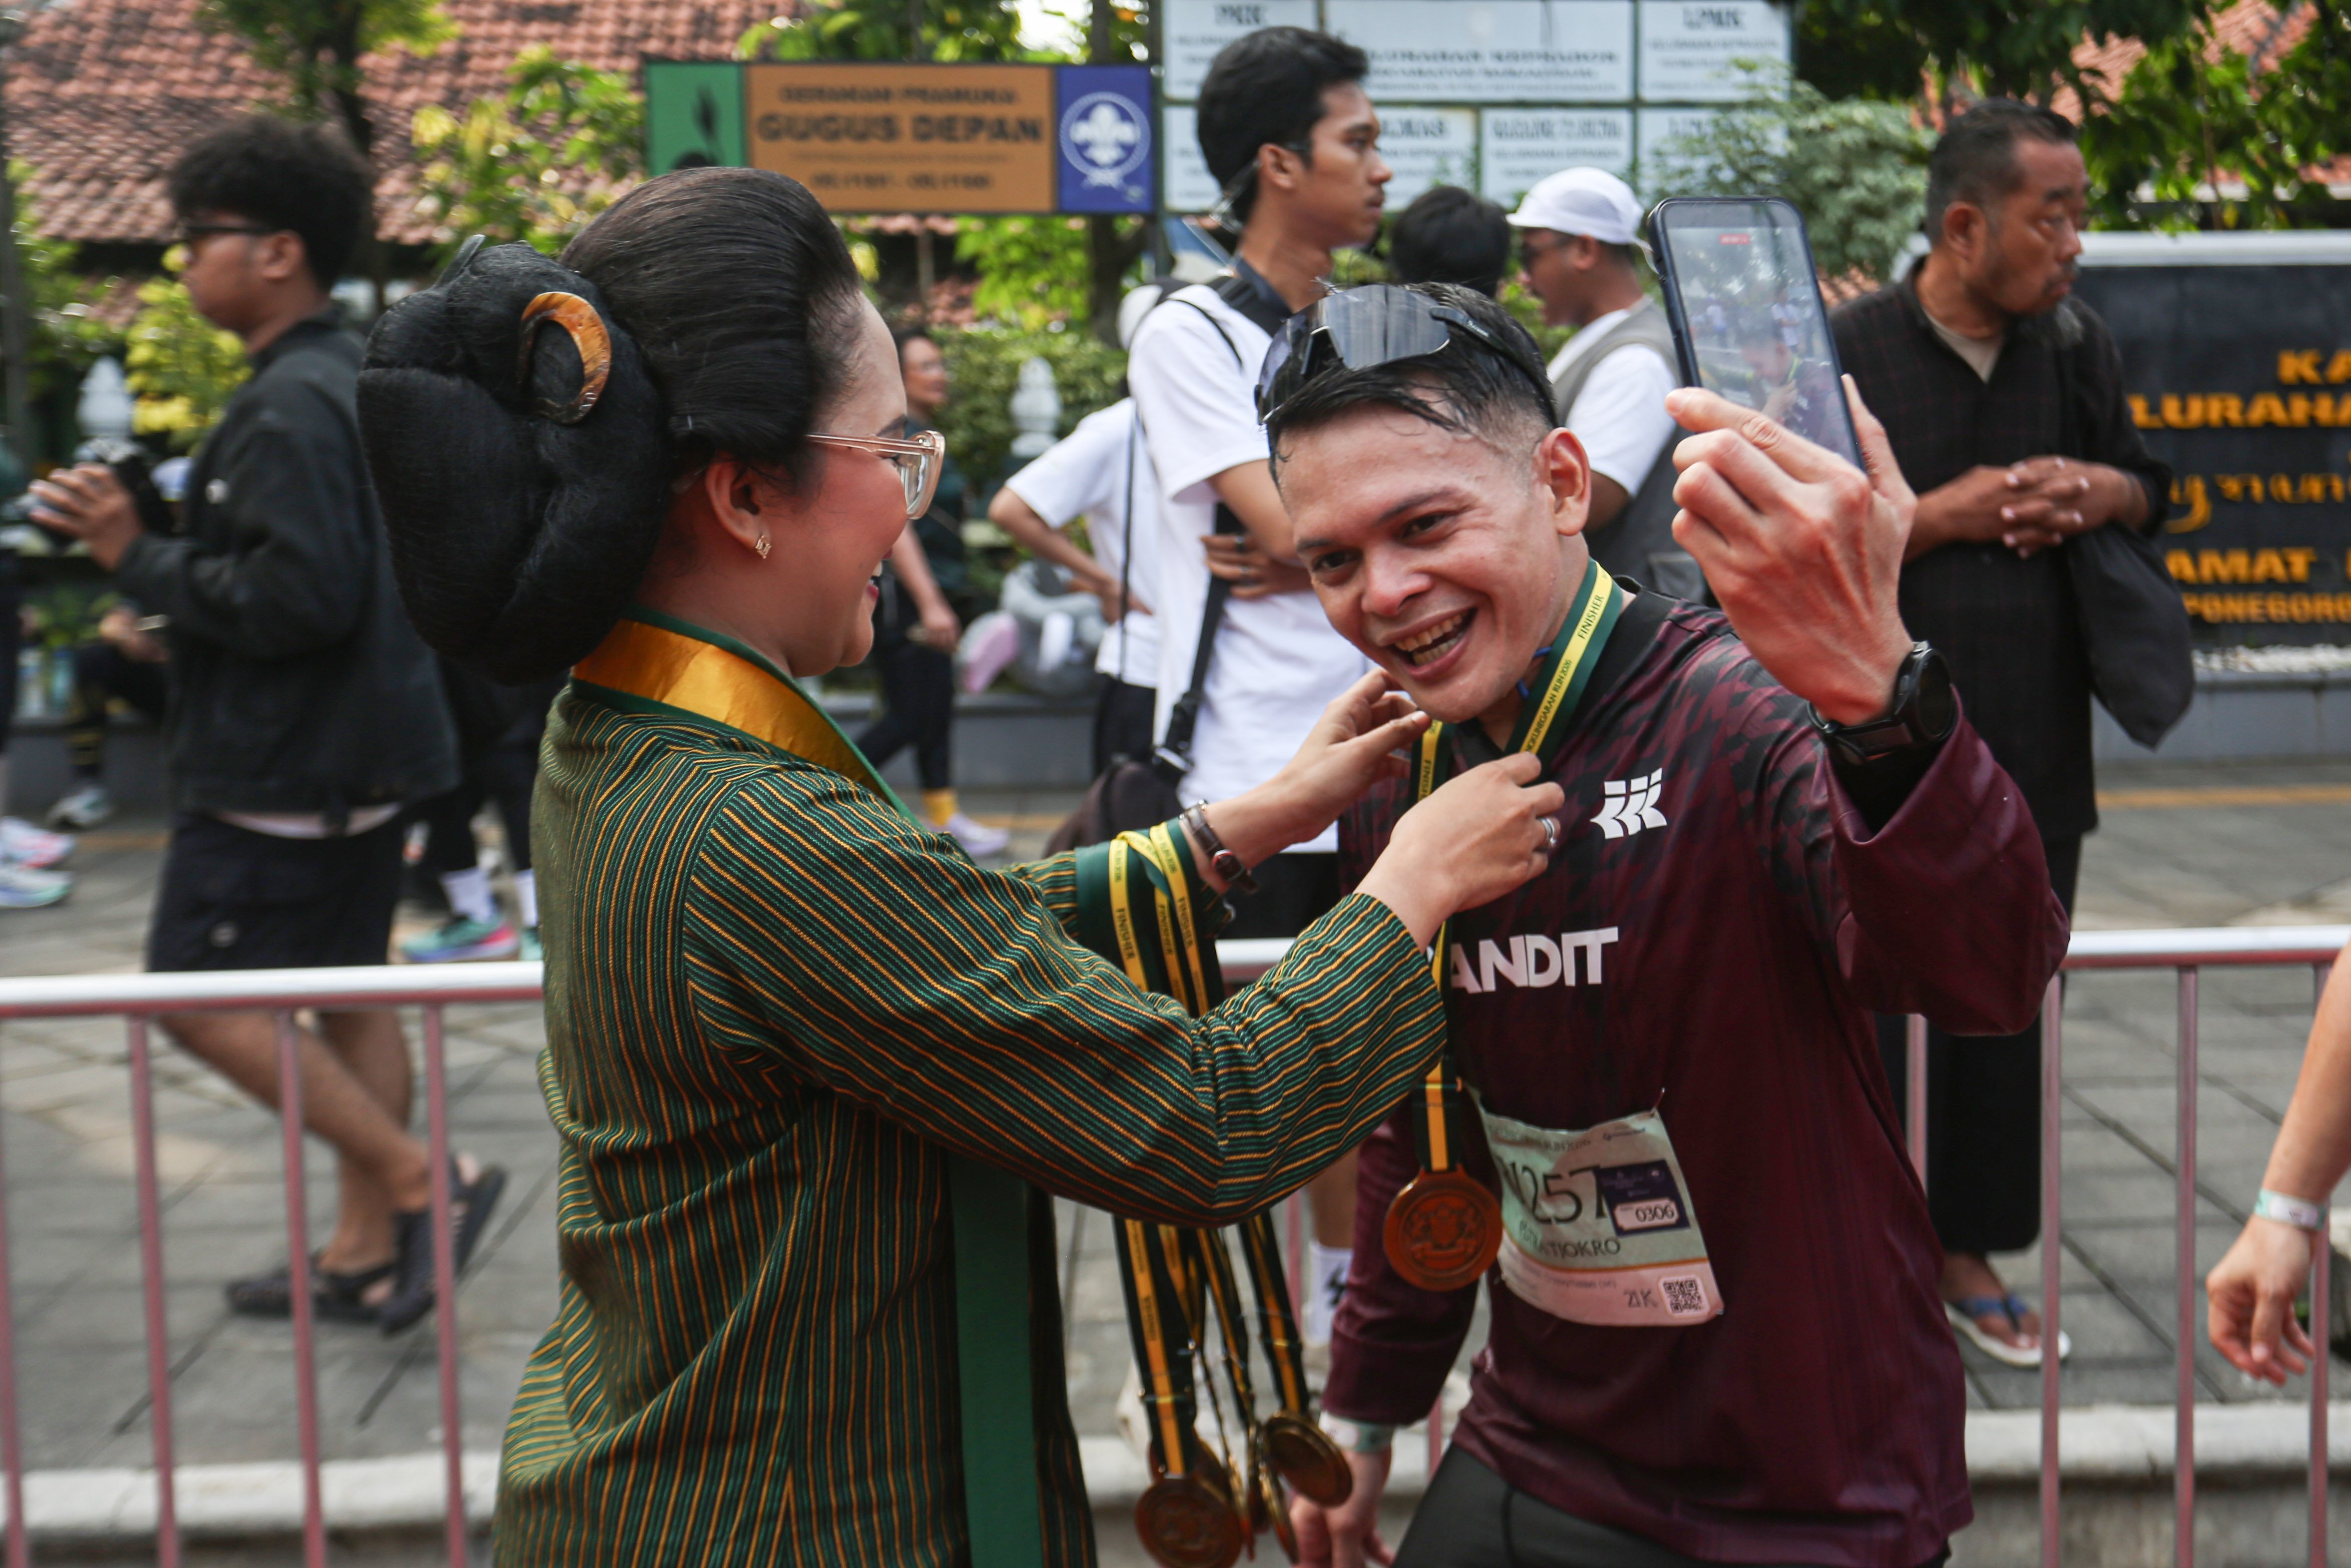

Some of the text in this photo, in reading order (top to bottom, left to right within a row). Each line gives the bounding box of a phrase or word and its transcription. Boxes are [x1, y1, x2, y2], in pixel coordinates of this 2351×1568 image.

[757, 114, 1043, 143] GUGUS DEPAN
[1577, 595, 1604, 640] FINISHER
